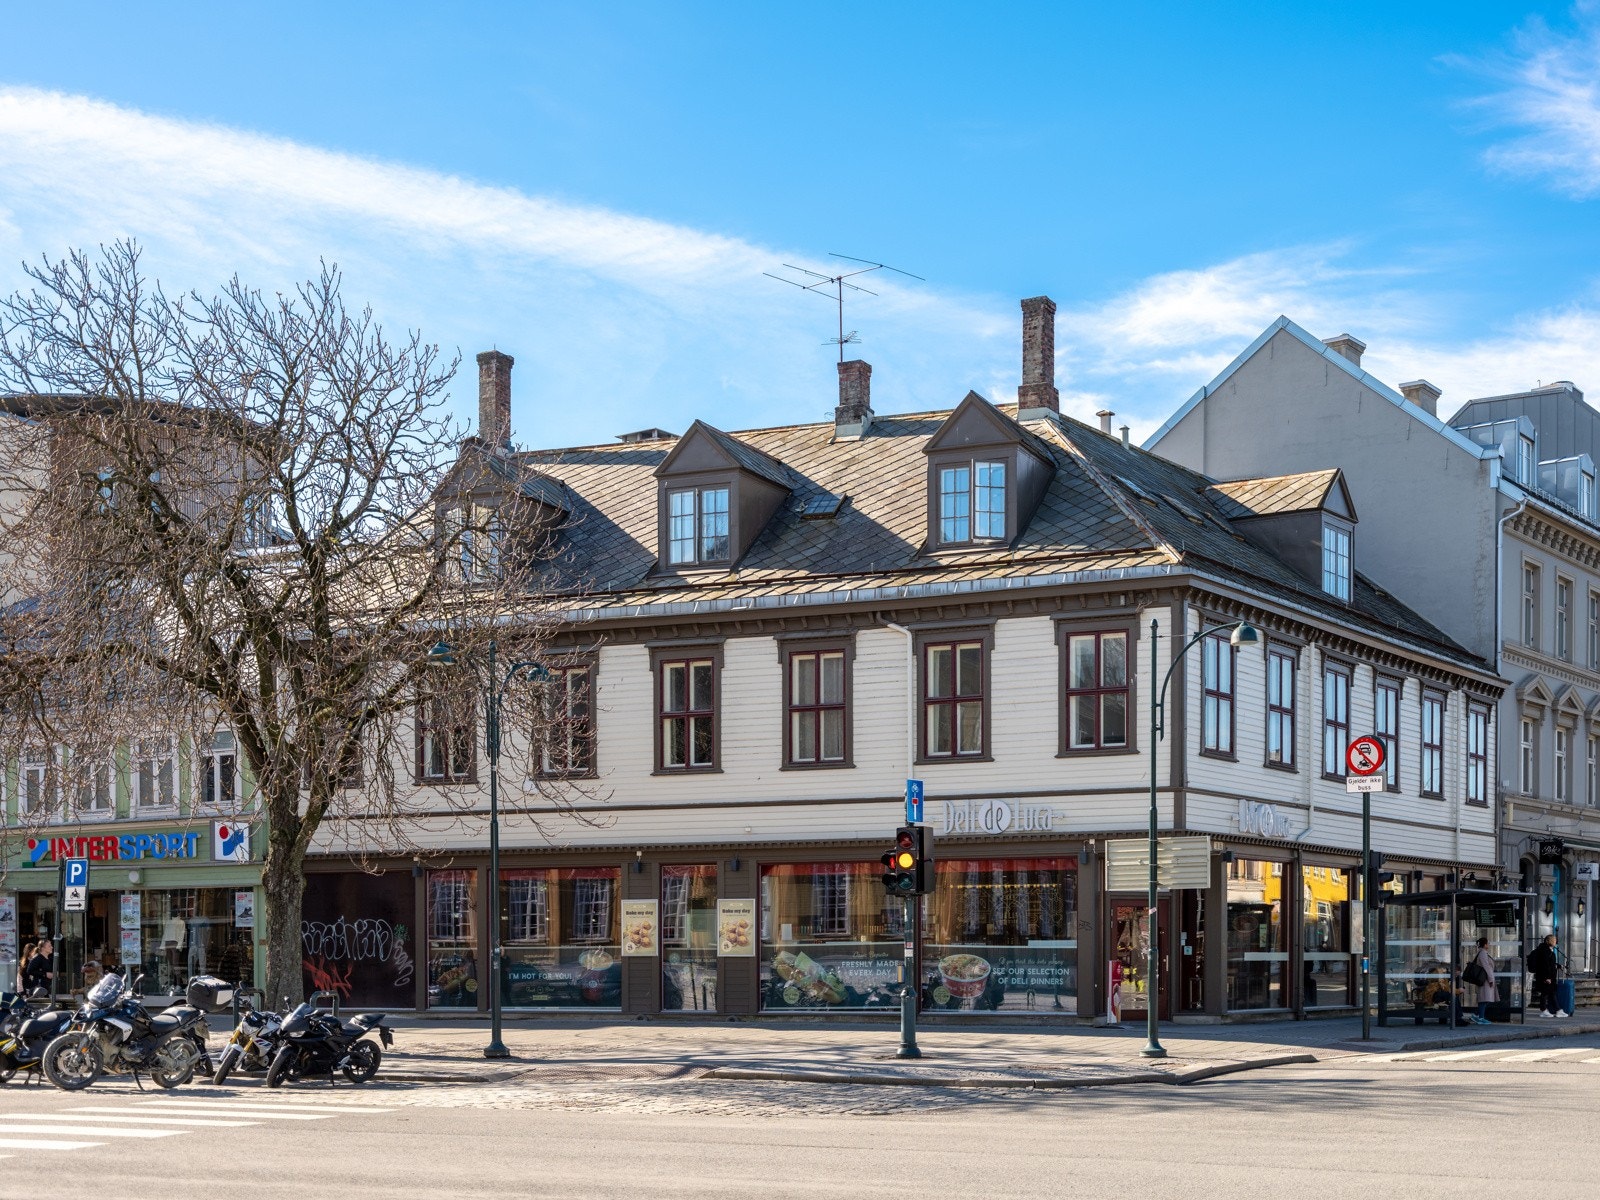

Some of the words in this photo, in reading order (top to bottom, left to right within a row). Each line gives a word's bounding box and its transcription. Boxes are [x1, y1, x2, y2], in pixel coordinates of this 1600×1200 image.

[943, 800, 976, 834] Deli
[985, 799, 1004, 832] de
[1014, 798, 1052, 831] Luca
[51, 832, 199, 861] INTERSPORT
[70, 863, 82, 883] P
[998, 977, 1009, 985] OF
[1011, 977, 1028, 985] DELI
[1030, 977, 1064, 985] DINNERS
